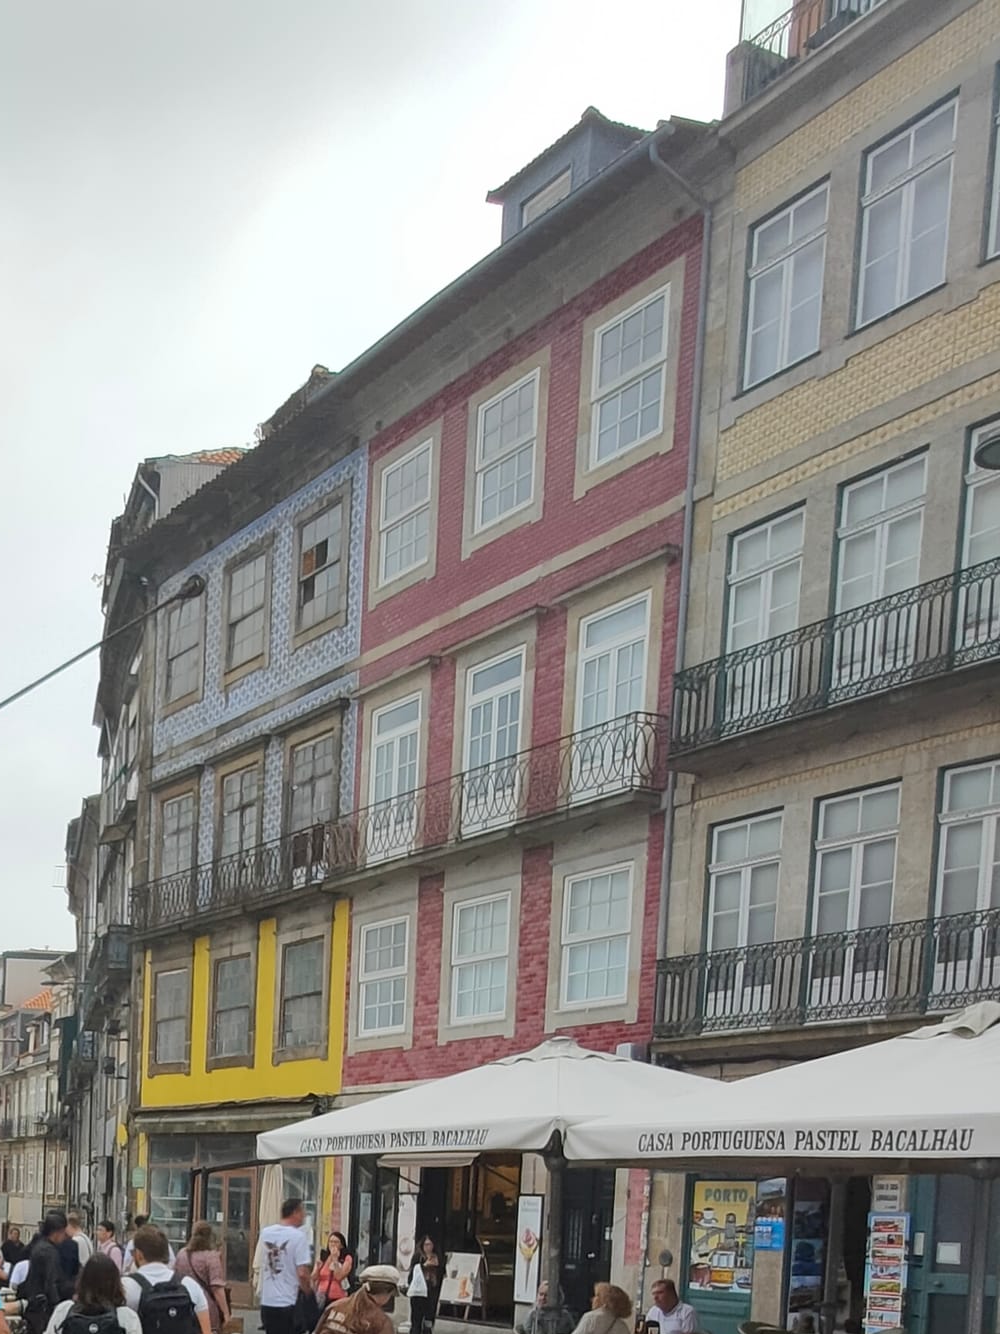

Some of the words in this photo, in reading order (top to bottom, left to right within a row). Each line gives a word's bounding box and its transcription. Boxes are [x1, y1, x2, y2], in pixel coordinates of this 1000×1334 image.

[300, 1138, 322, 1152] CASA
[326, 1133, 385, 1151] PORTUGUESA
[390, 1130, 427, 1147] PASTEL
[431, 1128, 489, 1146] BACALHAU
[638, 1133, 674, 1152] CASA
[680, 1130, 786, 1151] PORTUGUESA
[793, 1130, 862, 1150] PASTEL
[869, 1129, 975, 1151] BACALHAU
[704, 1188, 749, 1203] PORTO
